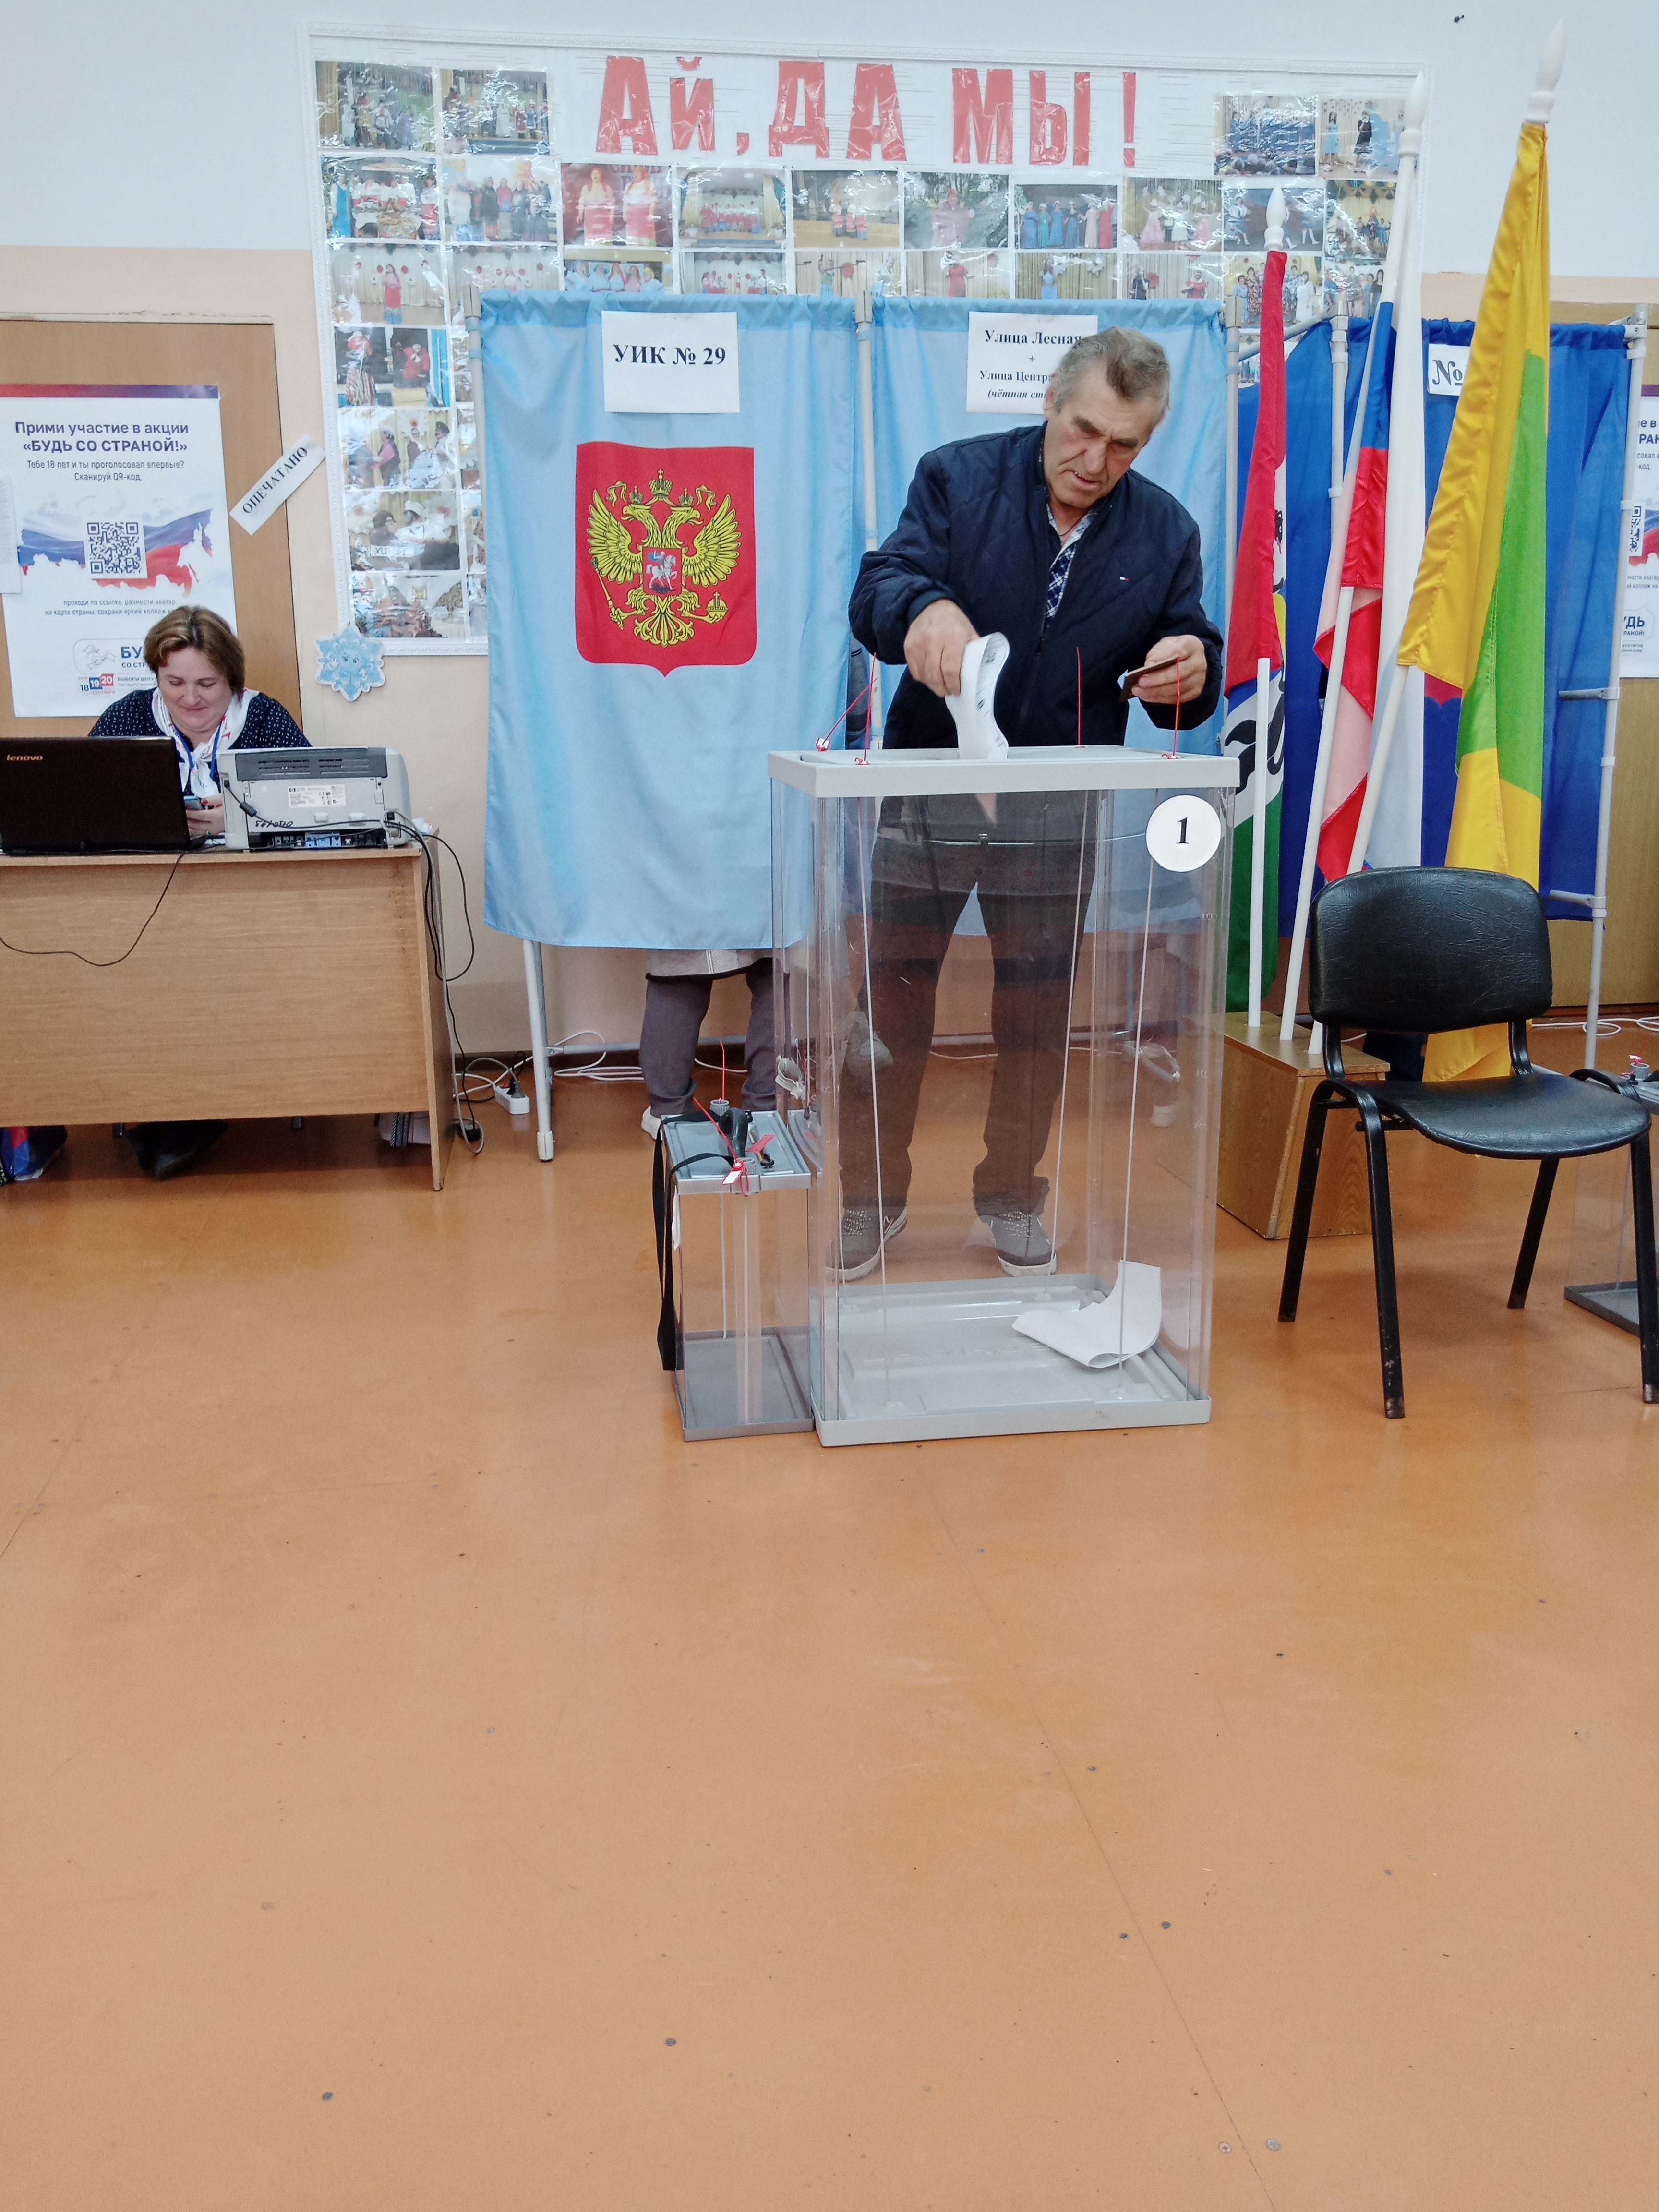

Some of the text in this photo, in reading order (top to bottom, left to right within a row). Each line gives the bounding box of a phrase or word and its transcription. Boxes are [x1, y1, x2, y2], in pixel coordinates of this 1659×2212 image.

[769, 60, 906, 161] ДА
[985, 330, 1082, 345] Улица Лесная
[613, 344, 726, 365] УИК № 29
[980, 371, 1052, 384] Улица Центра
[988, 389, 1027, 399] (чётная
[15, 422, 188, 436] Прими участие в акции
[1638, 420, 1647, 428] е
[24, 437, 187, 453] «БУДЬ СО СТРАНОЙ!»
[27, 460, 45, 469] Тебе
[147, 460, 184, 469] впервые?
[74, 472, 110, 482] Сканируй
[243, 447, 307, 513] ОПЕЧАТАНО
[120, 646, 143, 659] БУ
[90, 679, 100, 688] 19
[1176, 817, 1189, 844] 1
